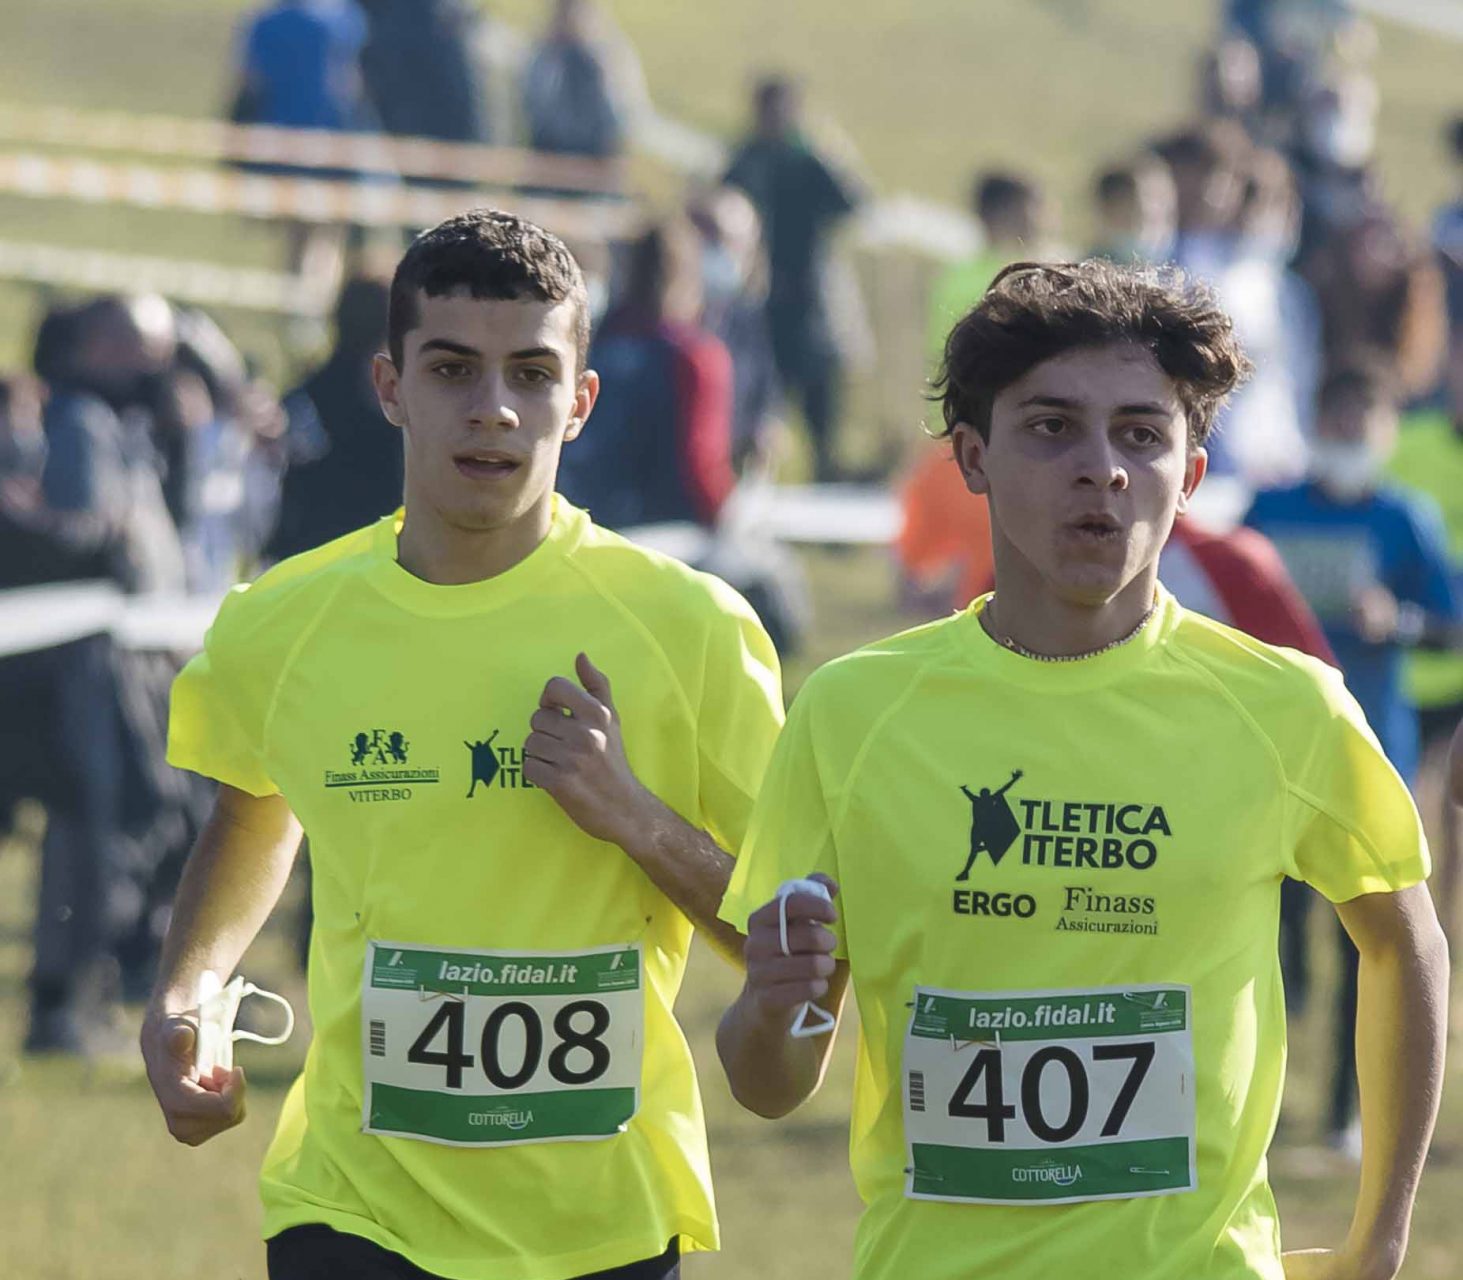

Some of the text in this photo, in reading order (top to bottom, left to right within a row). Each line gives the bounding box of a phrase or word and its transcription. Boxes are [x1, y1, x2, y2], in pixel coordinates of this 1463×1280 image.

[372, 729, 386, 747] F
[372, 748, 388, 765] A
[497, 747, 526, 766] TL
[325, 766, 440, 782] Finass Assicurazioni
[349, 788, 412, 802] VITERBO
[953, 890, 1036, 918] ERGO
[1064, 886, 1155, 914] Finass
[1055, 917, 1158, 935] Assicurazioni
[438, 961, 578, 984] lazio.fidal.it
[969, 1002, 1116, 1028] lazio.fidal.it
[408, 1000, 611, 1090] 408
[948, 1041, 1156, 1143] 407
[469, 1110, 534, 1130] COTTORELLA
[1012, 1164, 1083, 1186] COTTORELLA
